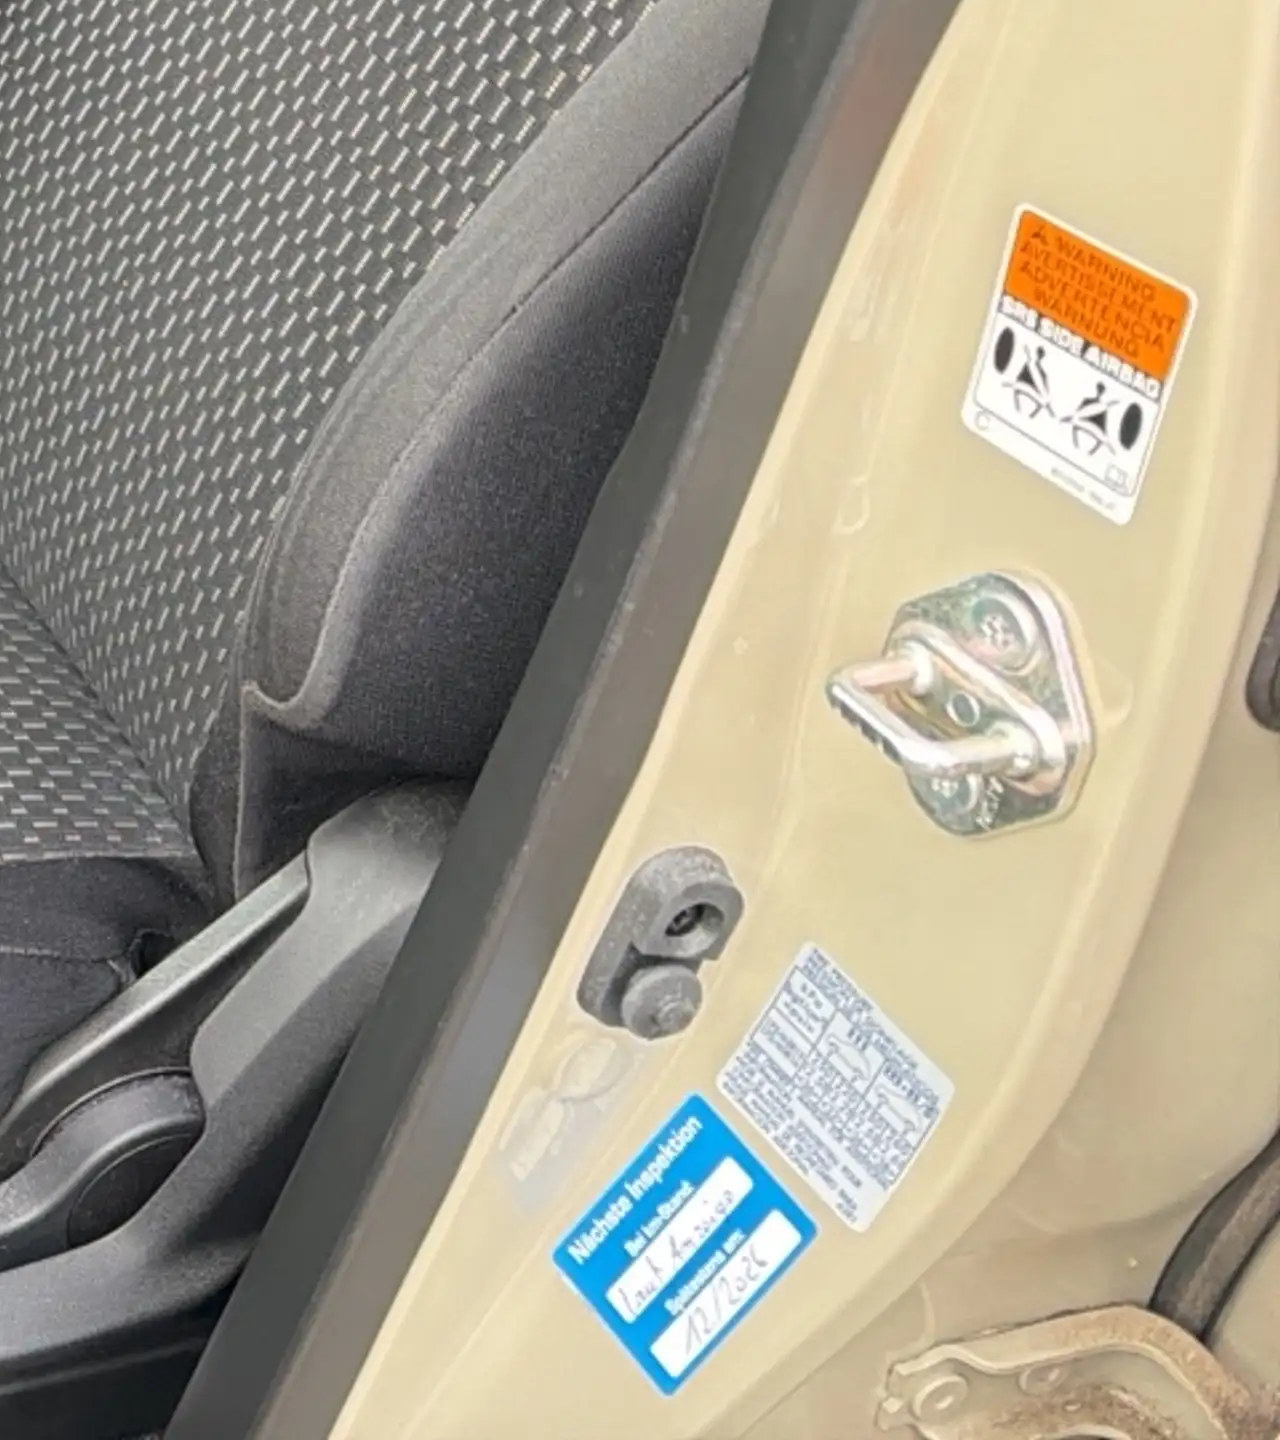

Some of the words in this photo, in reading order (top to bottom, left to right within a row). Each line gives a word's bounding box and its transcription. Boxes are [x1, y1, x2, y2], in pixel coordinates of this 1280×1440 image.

[1019, 239, 1176, 334] AVERTISSEMENT
[1054, 236, 1157, 302] WARNING
[566, 1187, 633, 1266] Nächste
[624, 1112, 703, 1200] Inspektion
